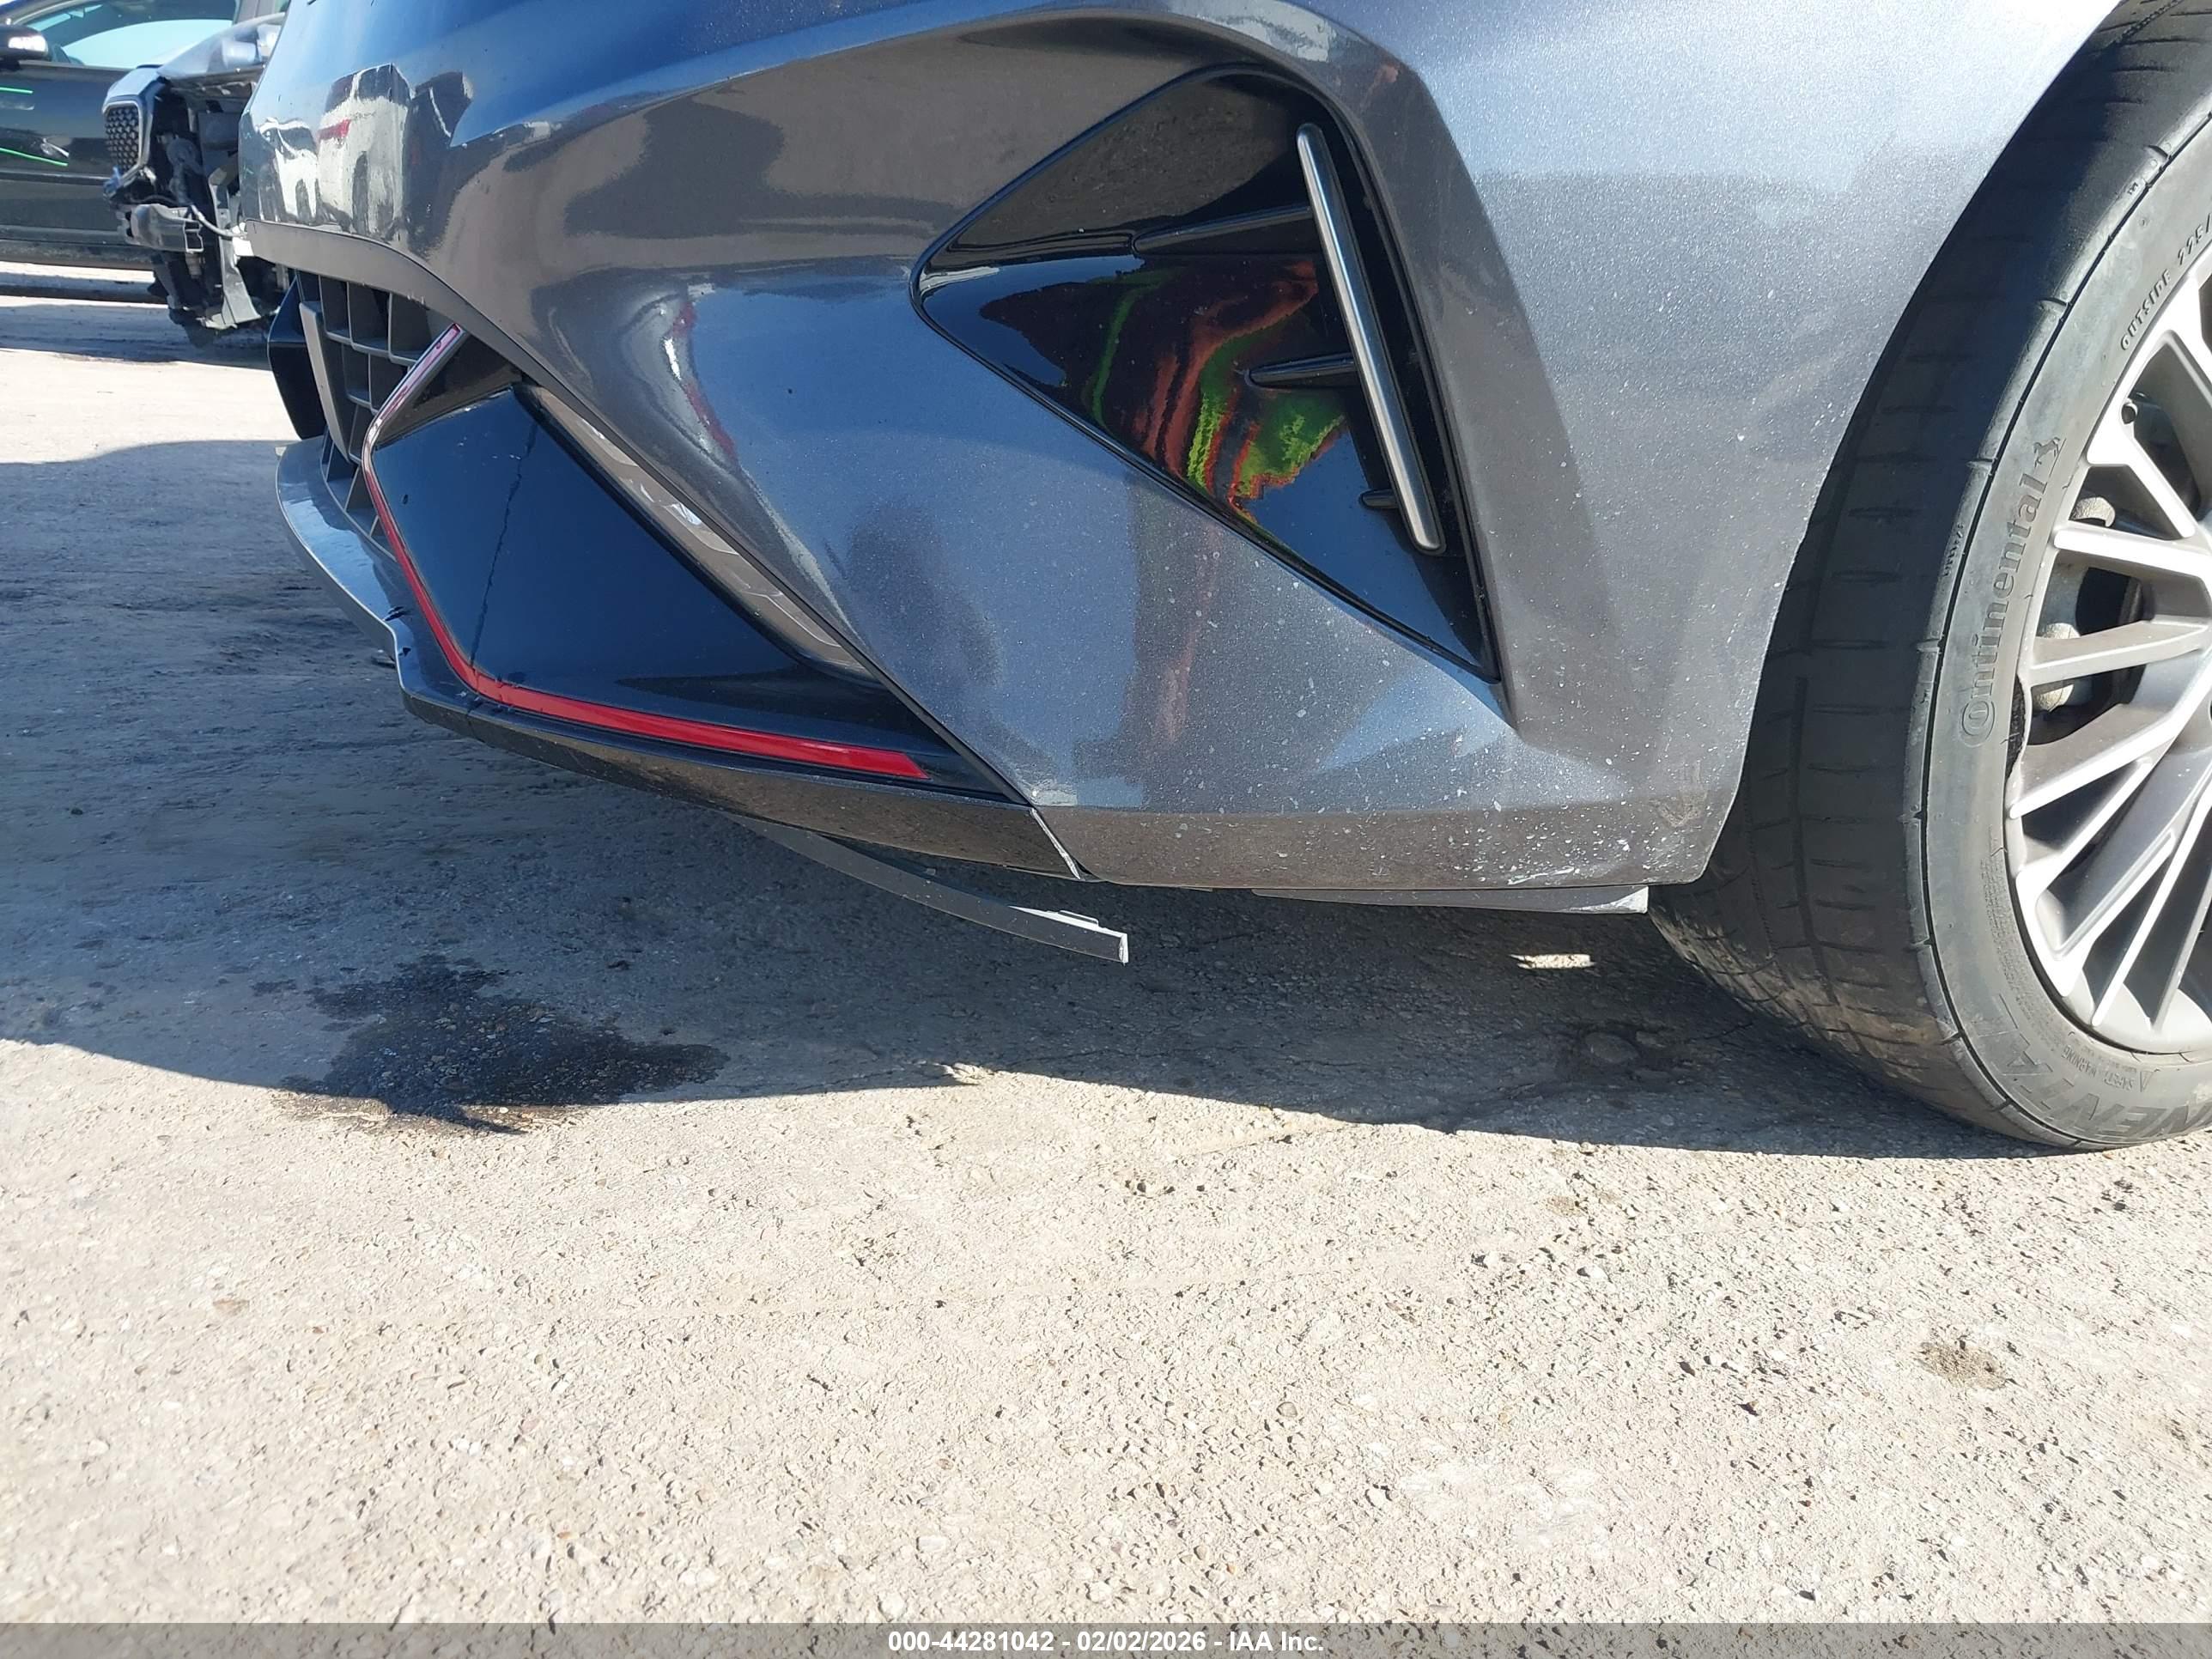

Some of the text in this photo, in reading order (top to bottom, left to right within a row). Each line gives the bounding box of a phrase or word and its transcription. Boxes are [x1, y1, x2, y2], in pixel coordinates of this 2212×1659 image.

[2120, 268, 2172, 351] OUTSIDE
[1960, 473, 2049, 746] Continental
[2062, 1044, 2097, 1077] WARNING
[2104, 1072, 2135, 1091] SAFETY
